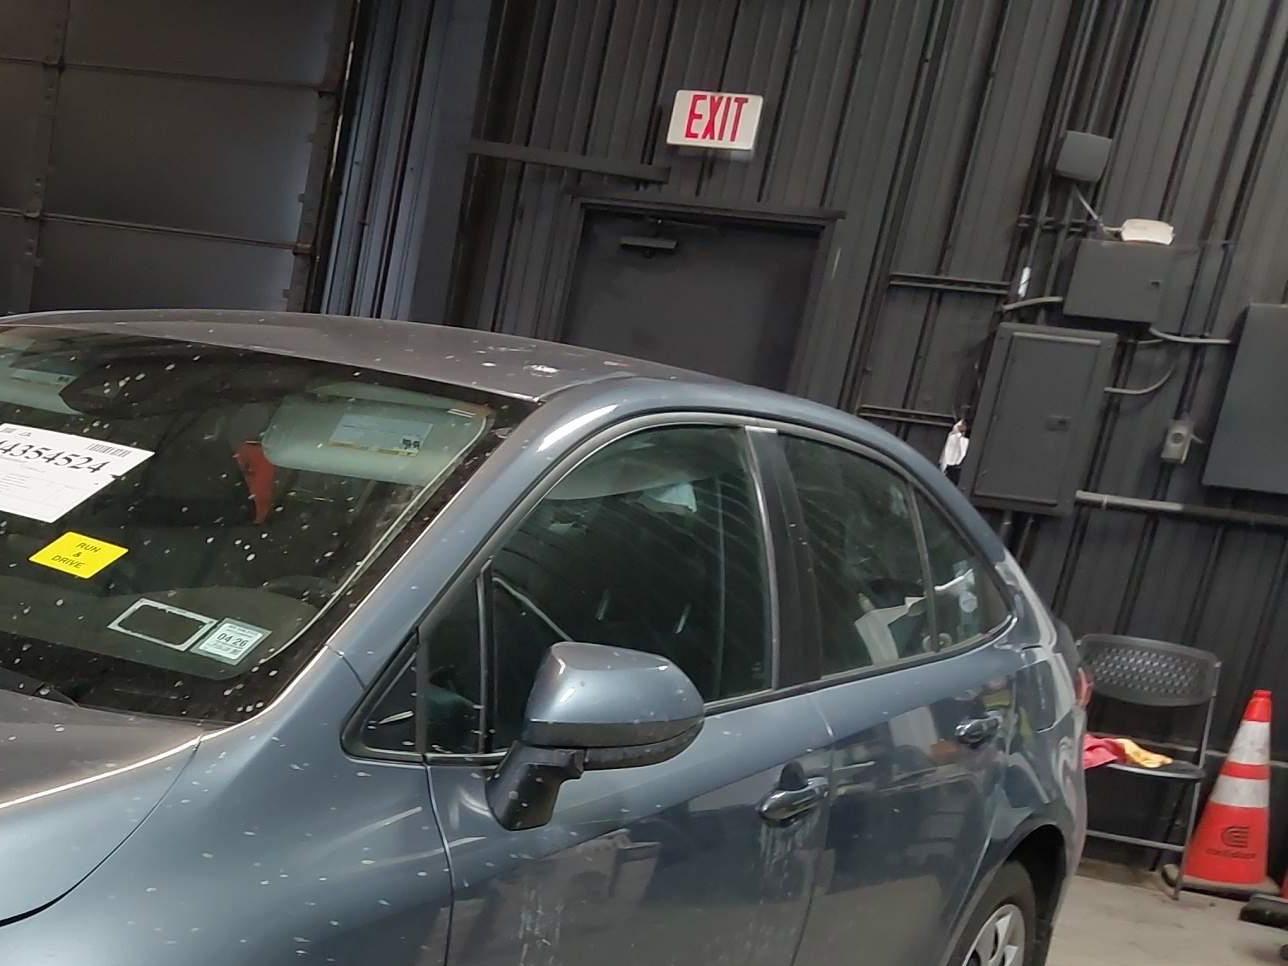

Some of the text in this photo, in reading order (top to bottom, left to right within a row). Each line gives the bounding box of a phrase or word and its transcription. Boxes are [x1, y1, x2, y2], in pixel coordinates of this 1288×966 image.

[685, 94, 749, 142] EXIT
[76, 542, 102, 553] RUN
[51, 554, 86, 569] DRIVE
